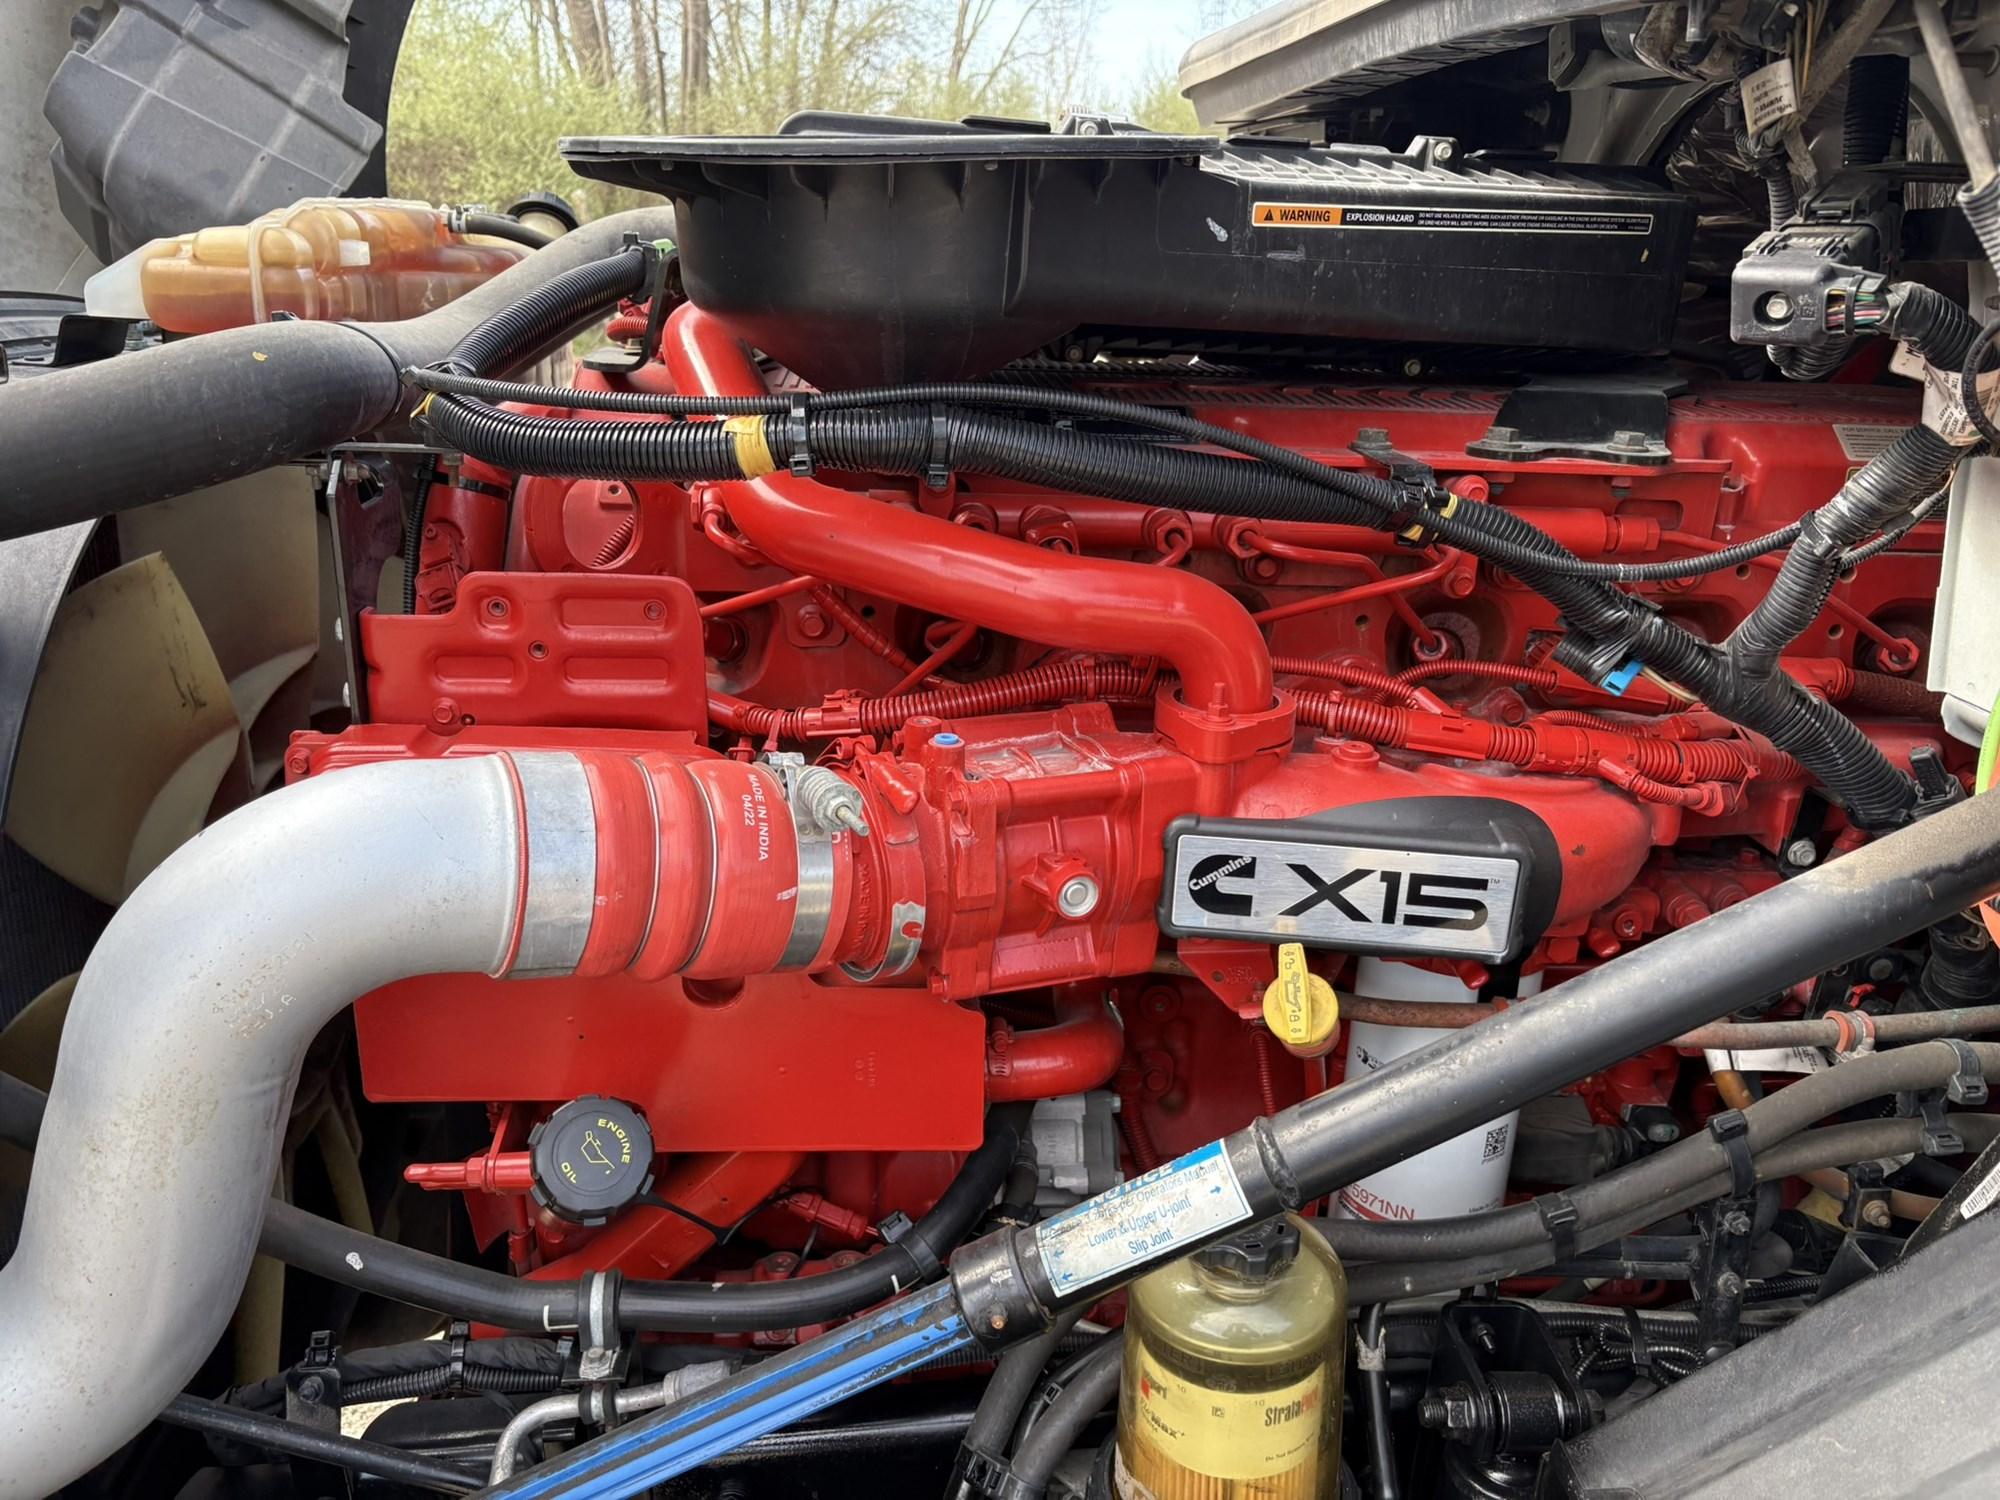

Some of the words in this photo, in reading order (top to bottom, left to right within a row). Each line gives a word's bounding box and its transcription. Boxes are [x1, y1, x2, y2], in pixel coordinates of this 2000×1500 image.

[1279, 209, 1331, 222] WARNING
[1346, 213, 1384, 223] EXPLOSION
[1386, 214, 1415, 223] HAZARD
[748, 773, 764, 803] MADE
[742, 794, 754, 827] 04/22
[755, 805, 767, 819] IN
[758, 821, 769, 862] INDIA
[1189, 856, 1252, 891] Cummins
[1278, 863, 1489, 931] X15
[597, 1118, 631, 1164] ENGINE
[561, 1162, 577, 1184] OIL
[1136, 1173, 1183, 1203] Operators
[1350, 1183, 1415, 1221] 5971NN
[1088, 1225, 1117, 1247] Lower
[1120, 1224, 1128, 1237] &
[1130, 1212, 1157, 1235] Upper
[1159, 1195, 1193, 1223] U-joint
[1128, 1238, 1149, 1258] Slip
[1150, 1229, 1174, 1249] Joint
